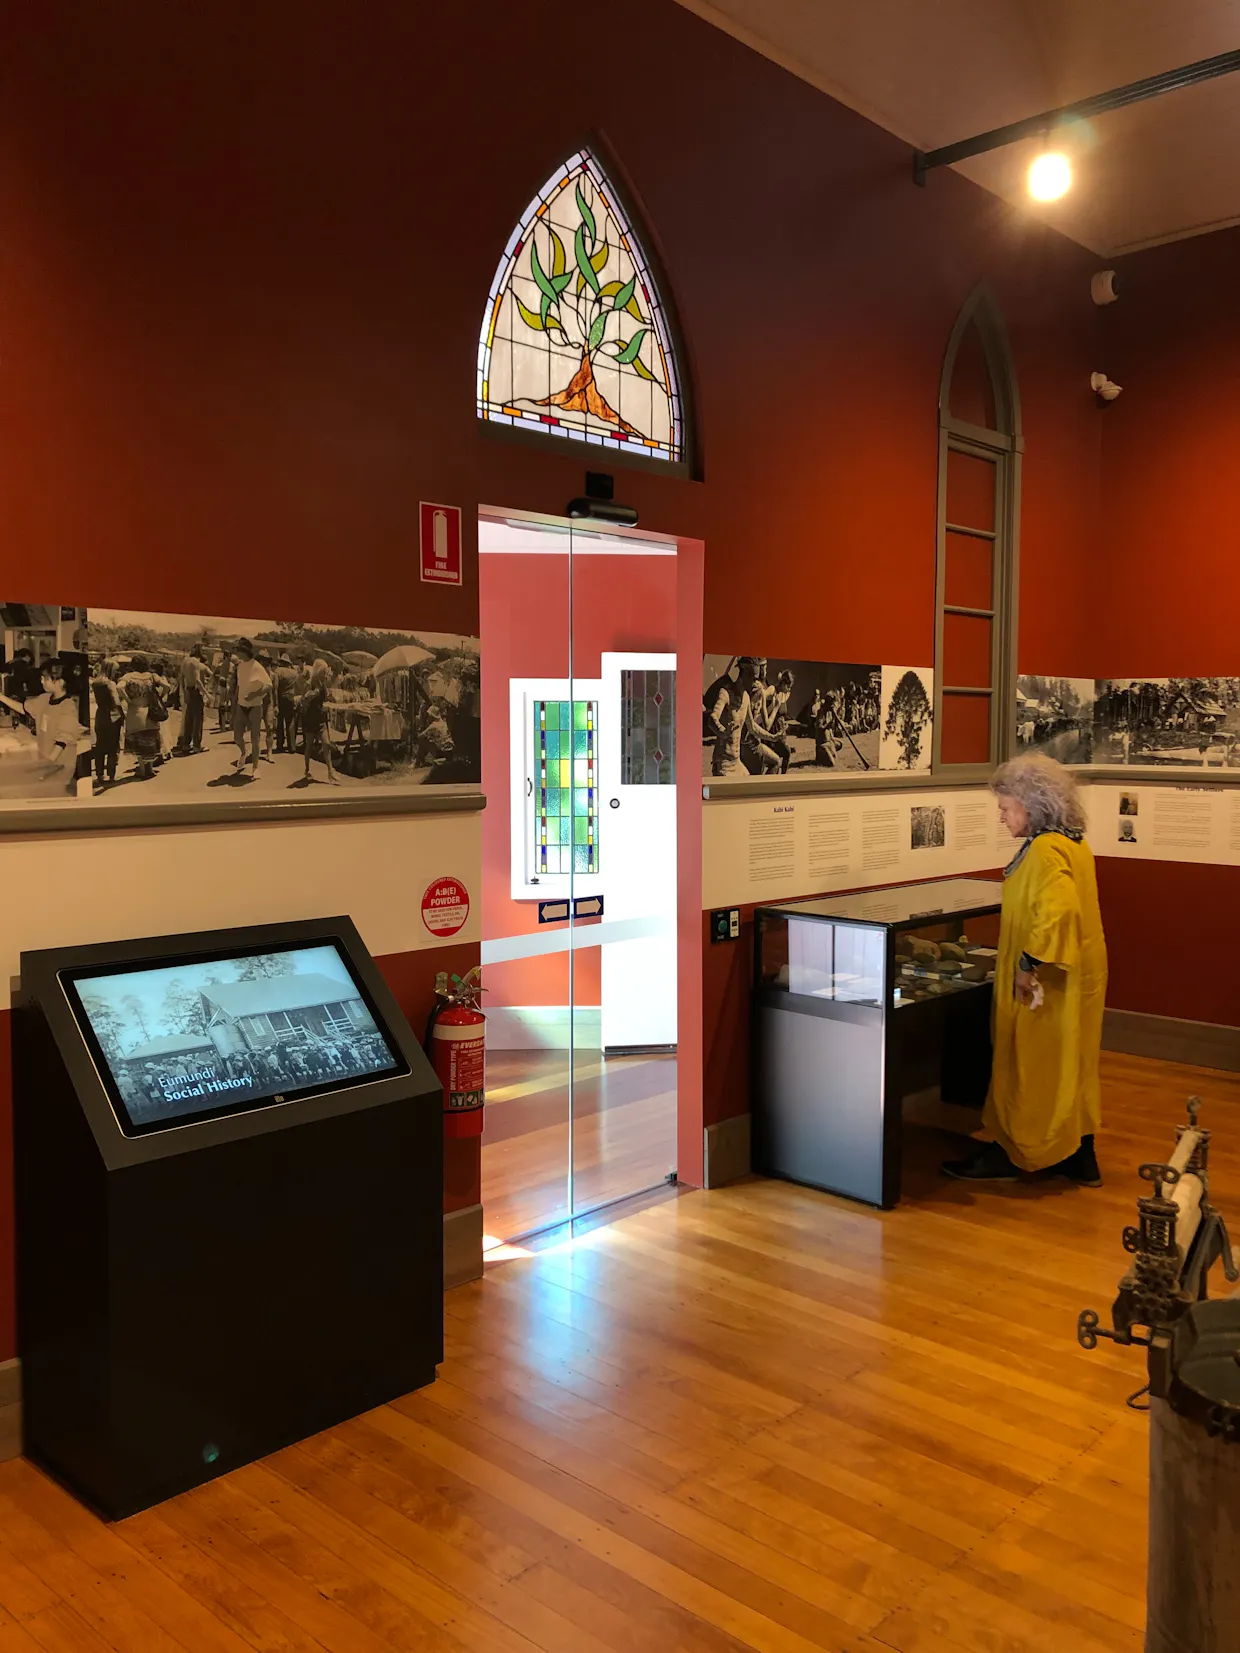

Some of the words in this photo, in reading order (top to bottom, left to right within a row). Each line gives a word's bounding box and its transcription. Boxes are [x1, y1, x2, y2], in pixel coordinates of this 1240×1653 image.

[430, 895, 461, 906] POWDER
[158, 1067, 215, 1088] Eumundi
[164, 1084, 204, 1102] Social
[207, 1076, 253, 1093] History
